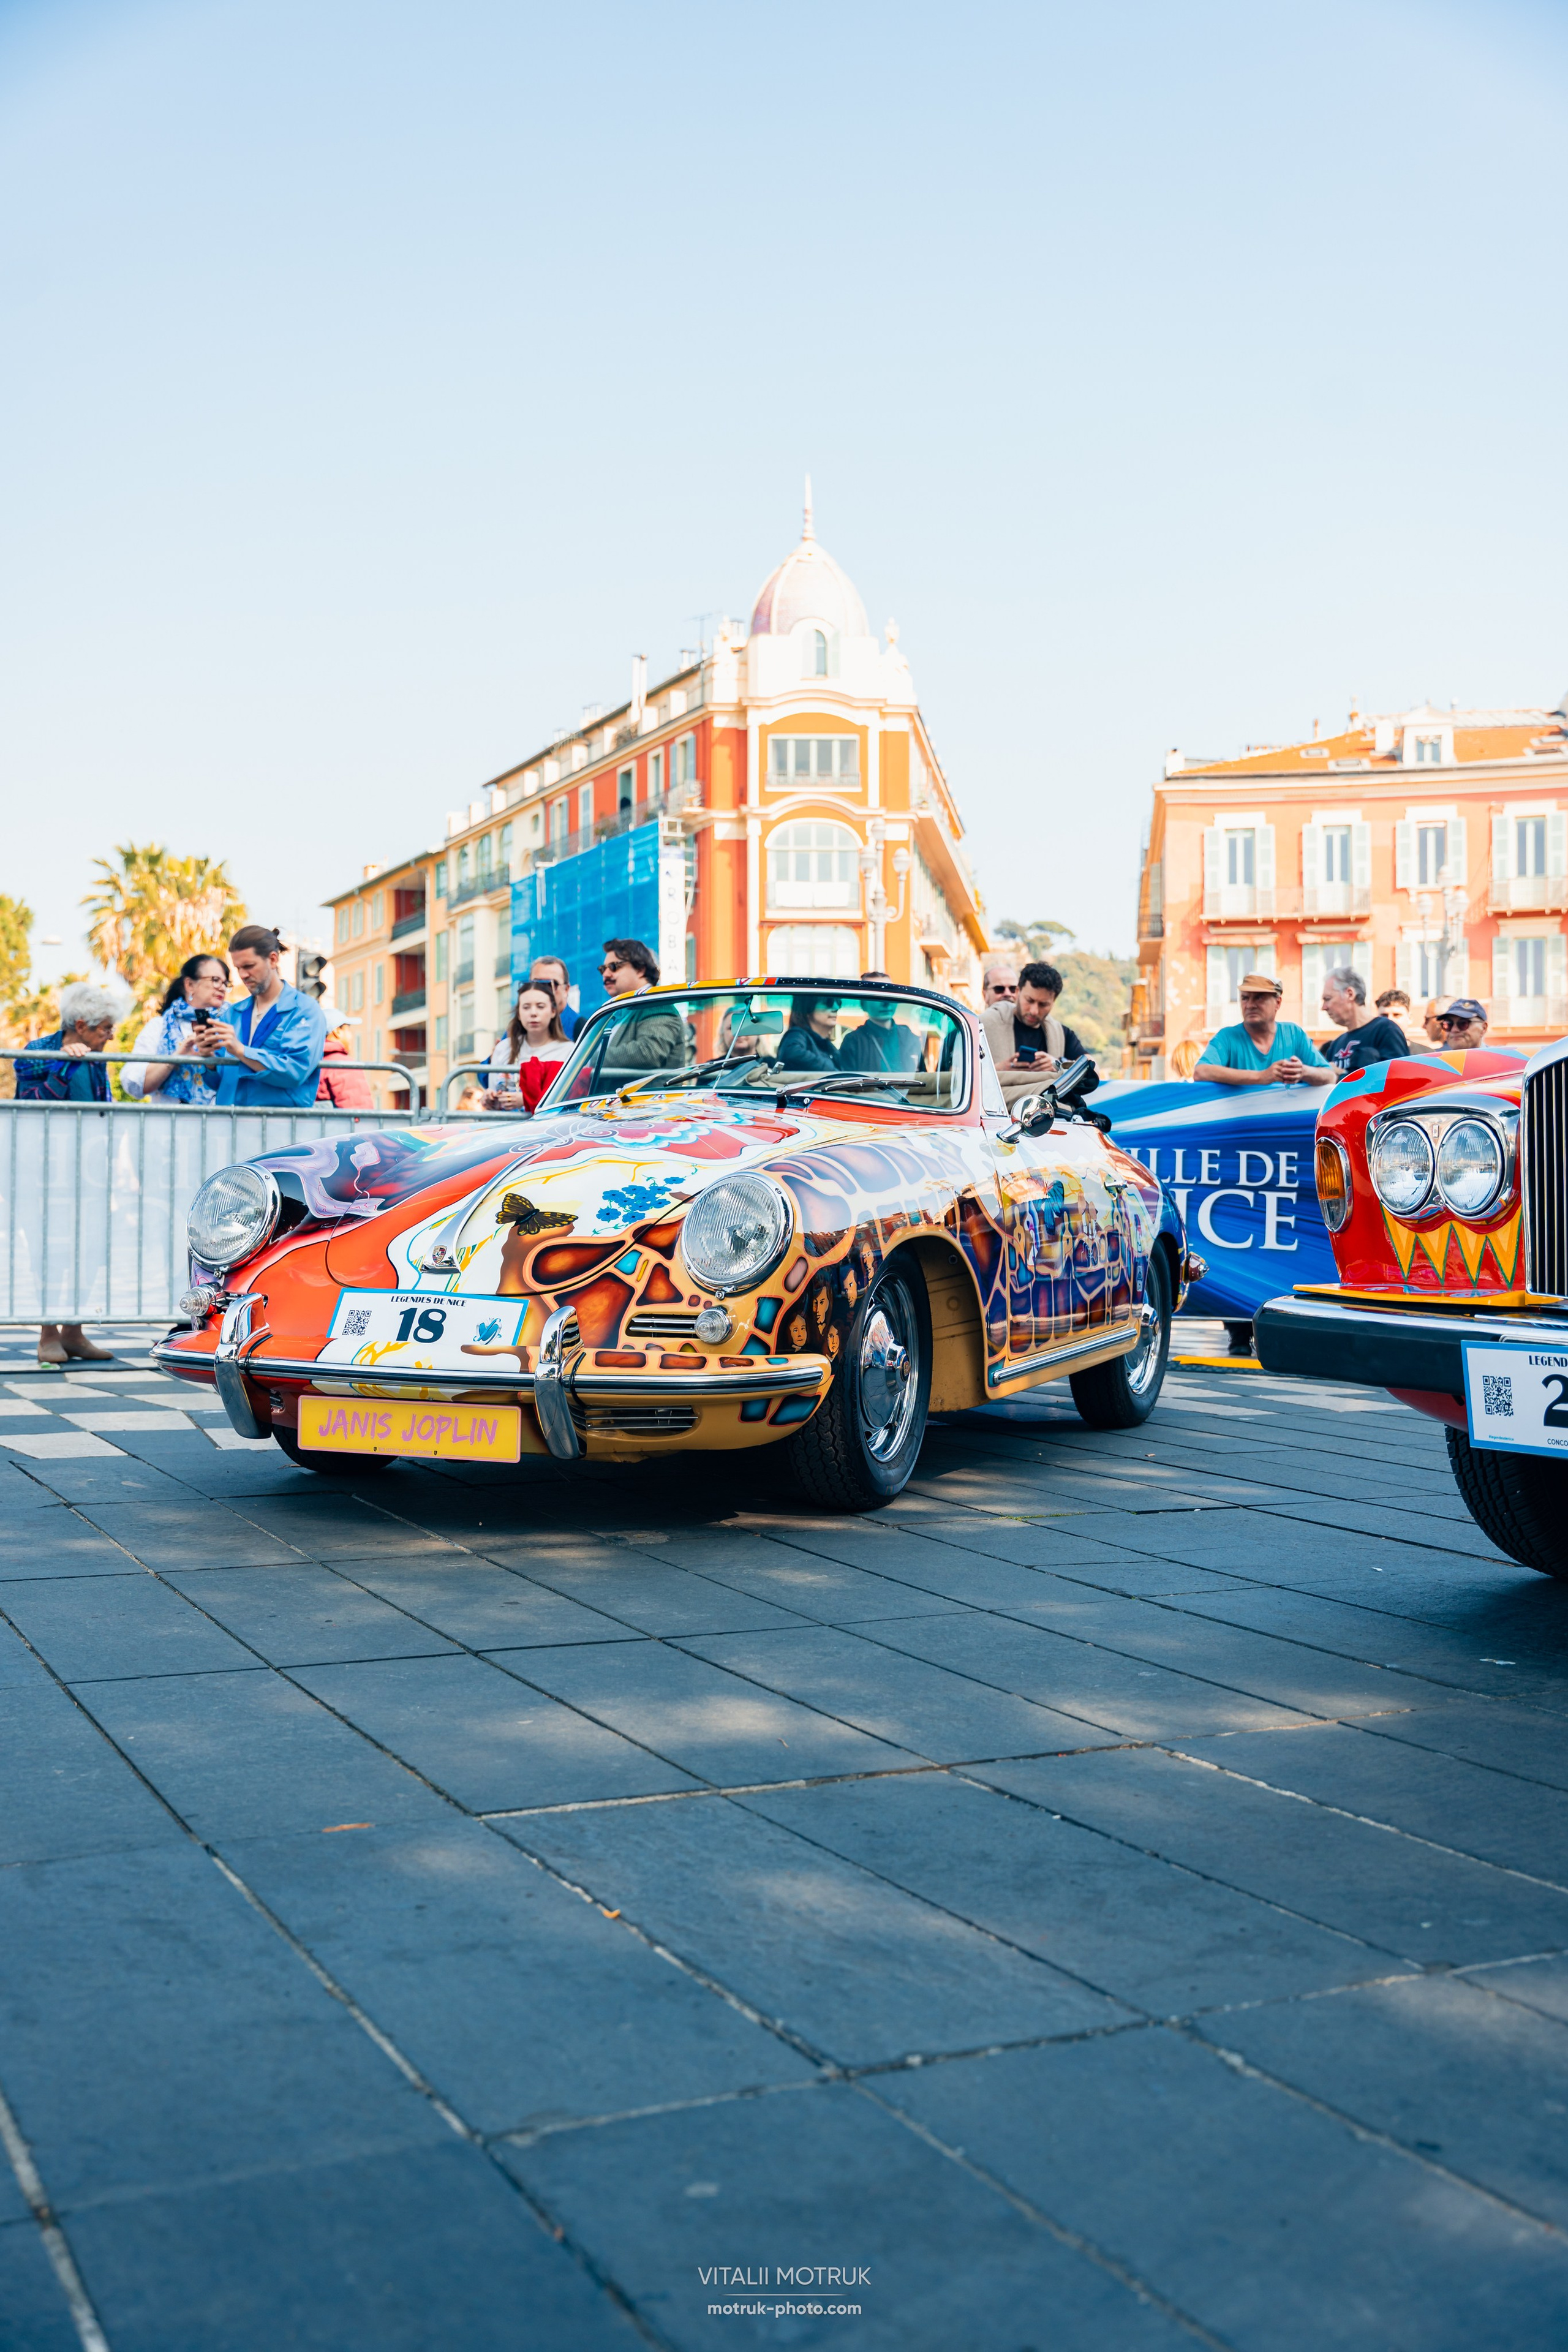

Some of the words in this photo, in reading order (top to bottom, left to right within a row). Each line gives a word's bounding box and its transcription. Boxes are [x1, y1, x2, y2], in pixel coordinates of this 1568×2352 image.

[1123, 1147, 1221, 1185] LLE
[1236, 1150, 1298, 1188] DE
[1169, 1188, 1298, 1251] ICE
[396, 1308, 447, 1343] 18
[318, 1409, 392, 1440] JANIS
[401, 1413, 499, 1446] JOPLIN
